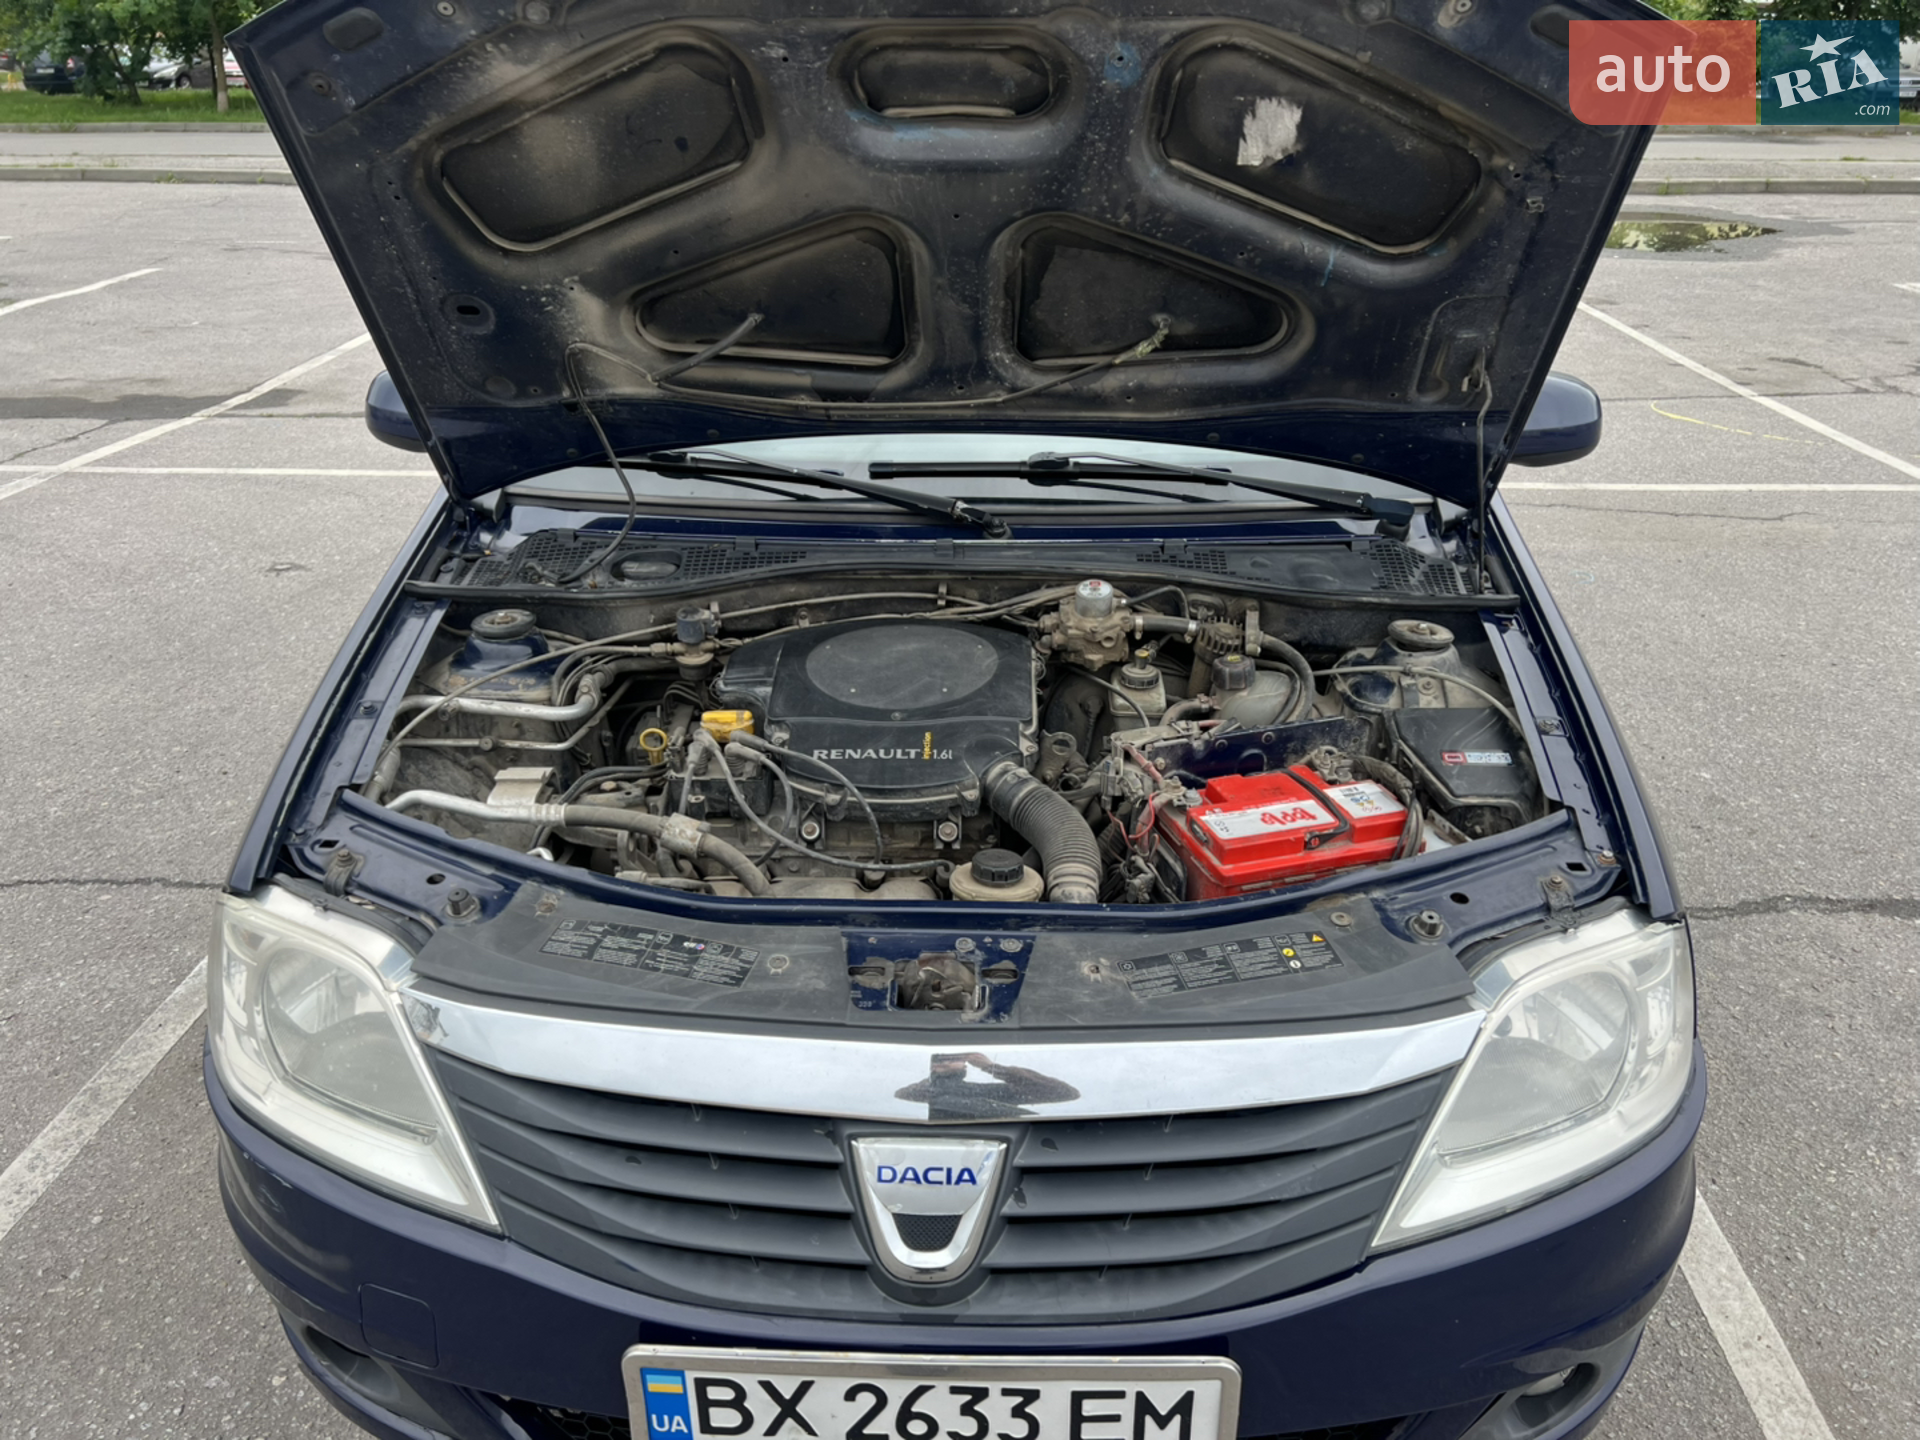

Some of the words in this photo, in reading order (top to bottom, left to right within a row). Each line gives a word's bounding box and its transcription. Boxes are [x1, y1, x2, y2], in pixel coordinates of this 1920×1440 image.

[812, 748, 922, 760] RENAULT
[876, 1165, 978, 1186] DACIA
[693, 1376, 819, 1437] BX
[843, 1382, 1041, 1440] 2633
[1069, 1389, 1195, 1440] EM
[651, 1413, 688, 1434] UA
